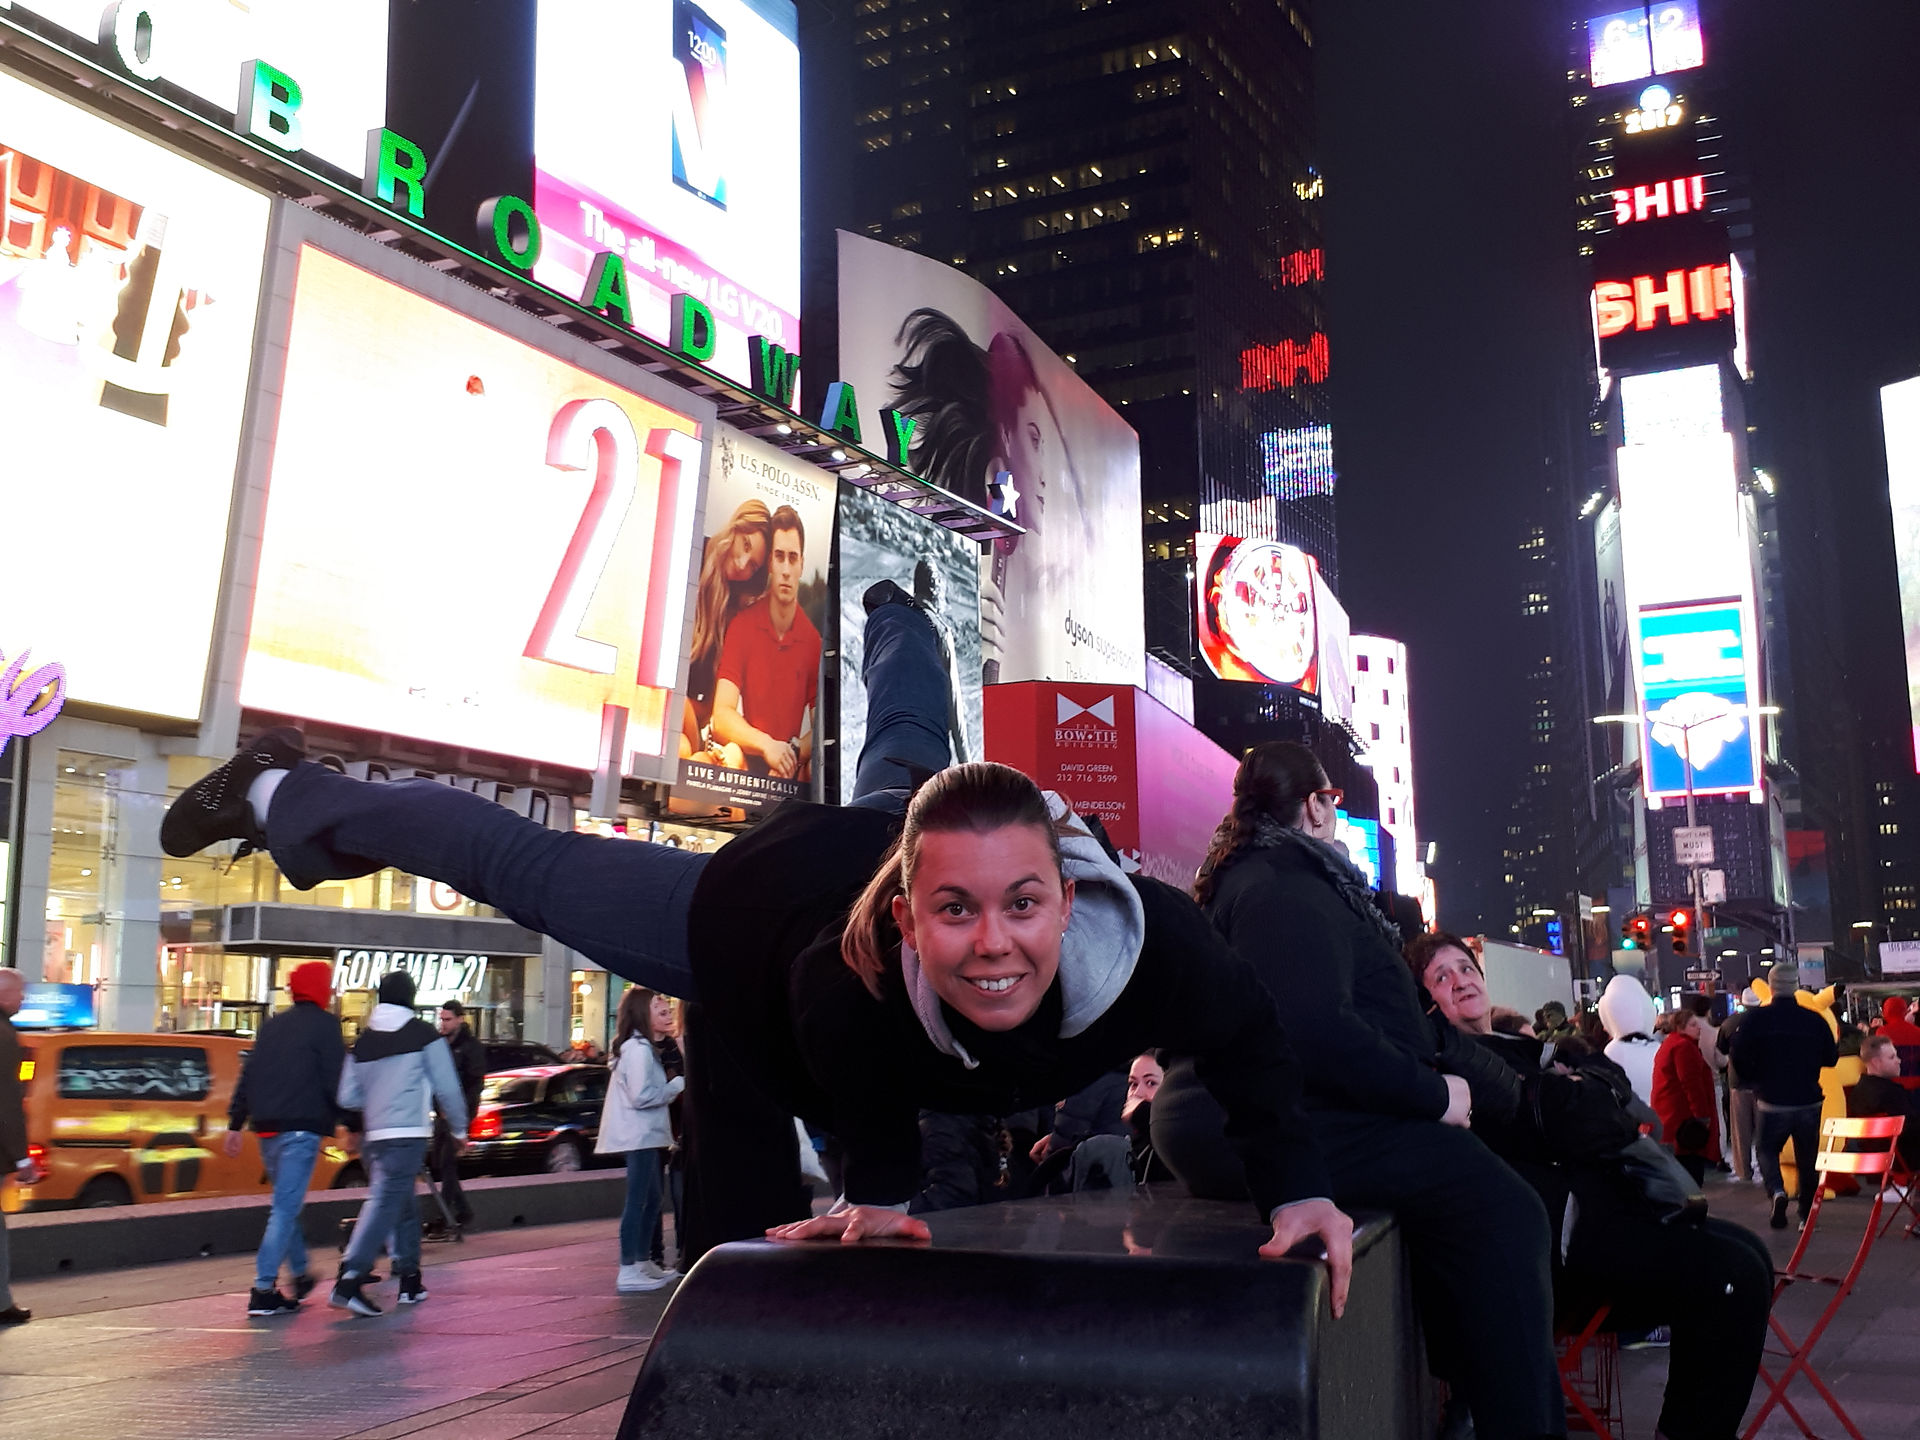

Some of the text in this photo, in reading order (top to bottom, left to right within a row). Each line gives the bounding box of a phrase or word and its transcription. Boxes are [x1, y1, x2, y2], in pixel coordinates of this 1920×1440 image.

[1624, 105, 1683, 134] 2017
[234, 58, 918, 466] BROADWAY
[580, 201, 626, 255] The
[628, 236, 708, 300] all-new
[710, 277, 739, 317] LG
[740, 453, 821, 502] U.S. POLO ASSN.
[523, 398, 703, 690] 21
[1064, 609, 1094, 648] dyson
[687, 765, 799, 796] LIVE AUTHENTICALLY
[1057, 773, 1118, 783] 212 716 3599
[1060, 763, 1113, 773] DAVID GREEN
[1074, 800, 1126, 810] MENDELSON
[1099, 811, 1121, 821] 3596
[1683, 841, 1703, 849] MUST
[332, 949, 489, 995] FOREVER 21
